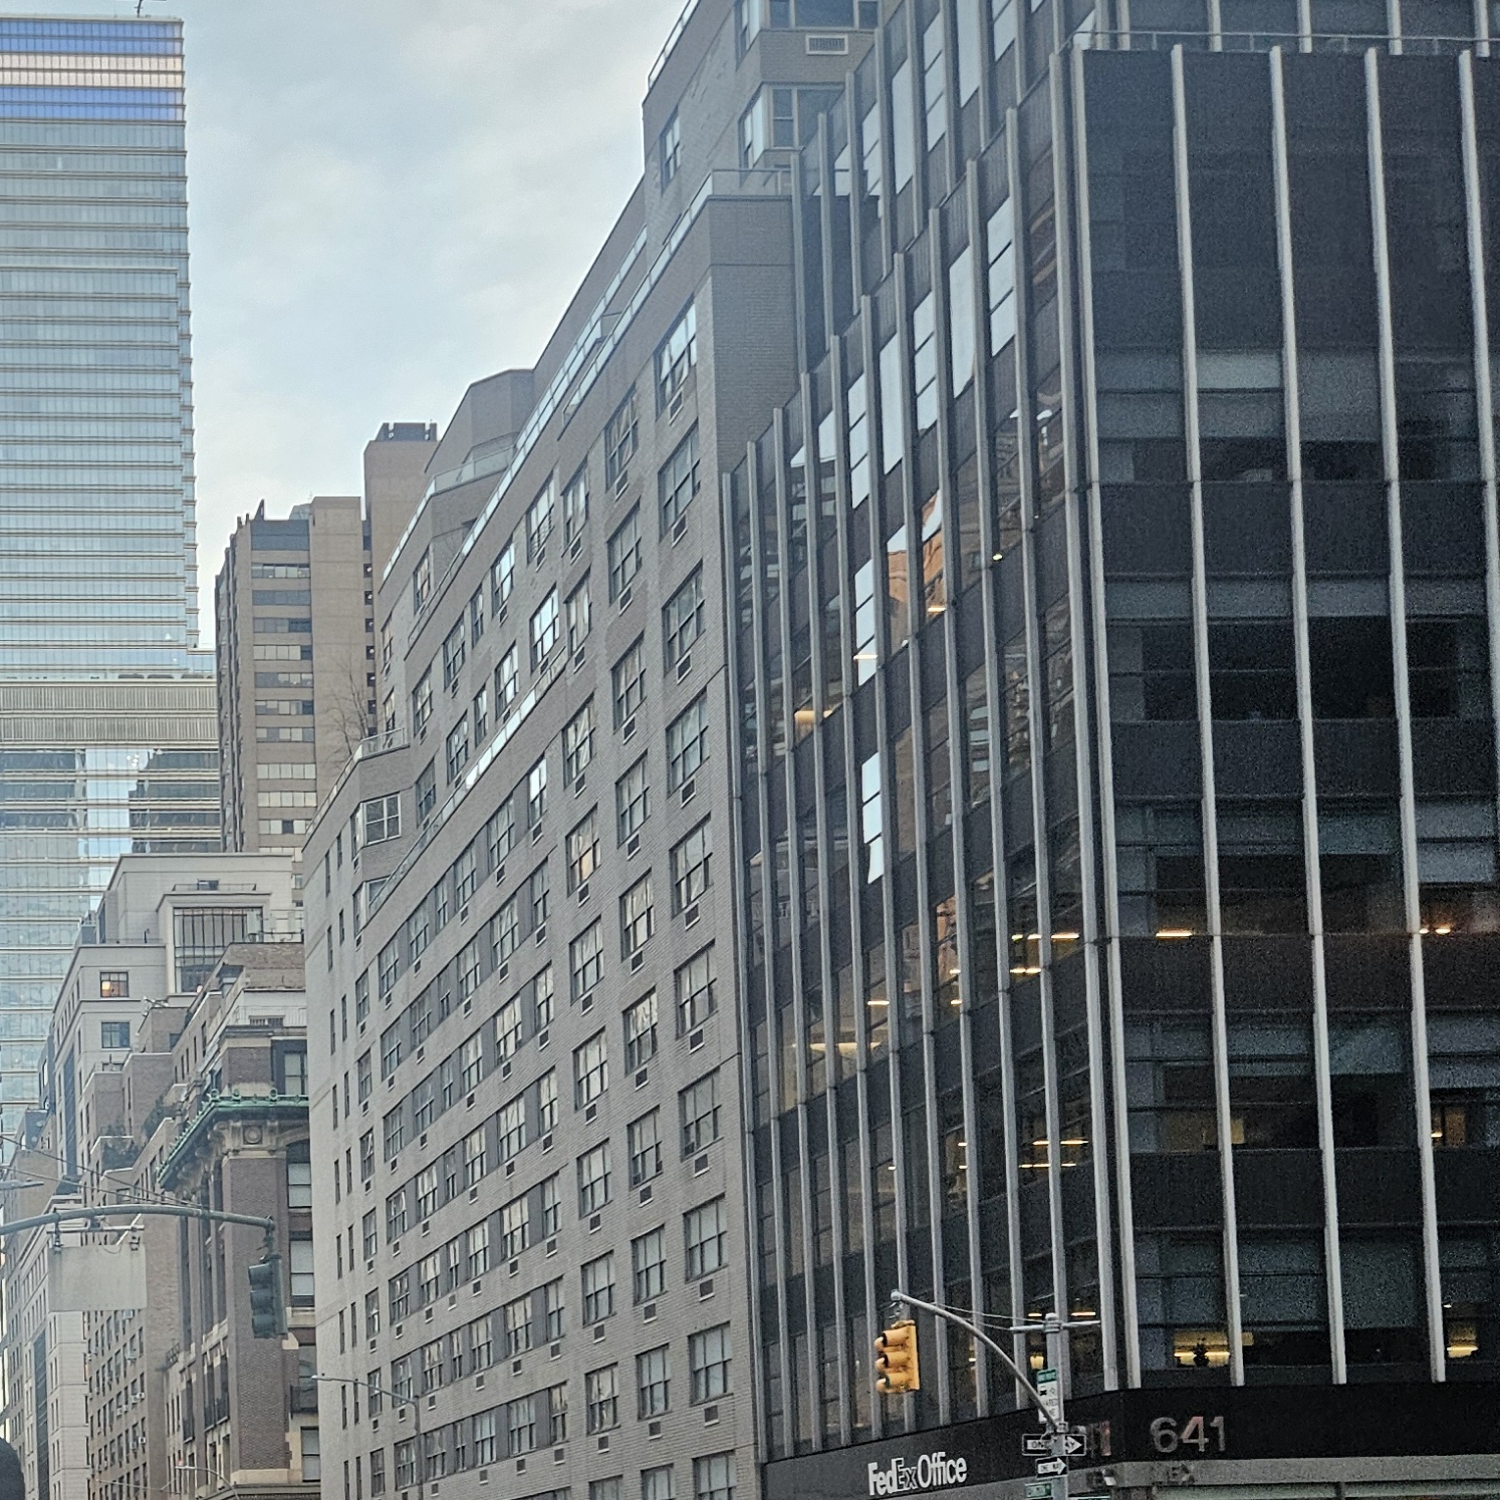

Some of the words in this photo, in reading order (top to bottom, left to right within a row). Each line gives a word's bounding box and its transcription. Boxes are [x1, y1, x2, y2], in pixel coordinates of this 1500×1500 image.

[1151, 1415, 1226, 1453] 641
[867, 1457, 918, 1496] FedEx
[917, 1451, 968, 1488] Office
